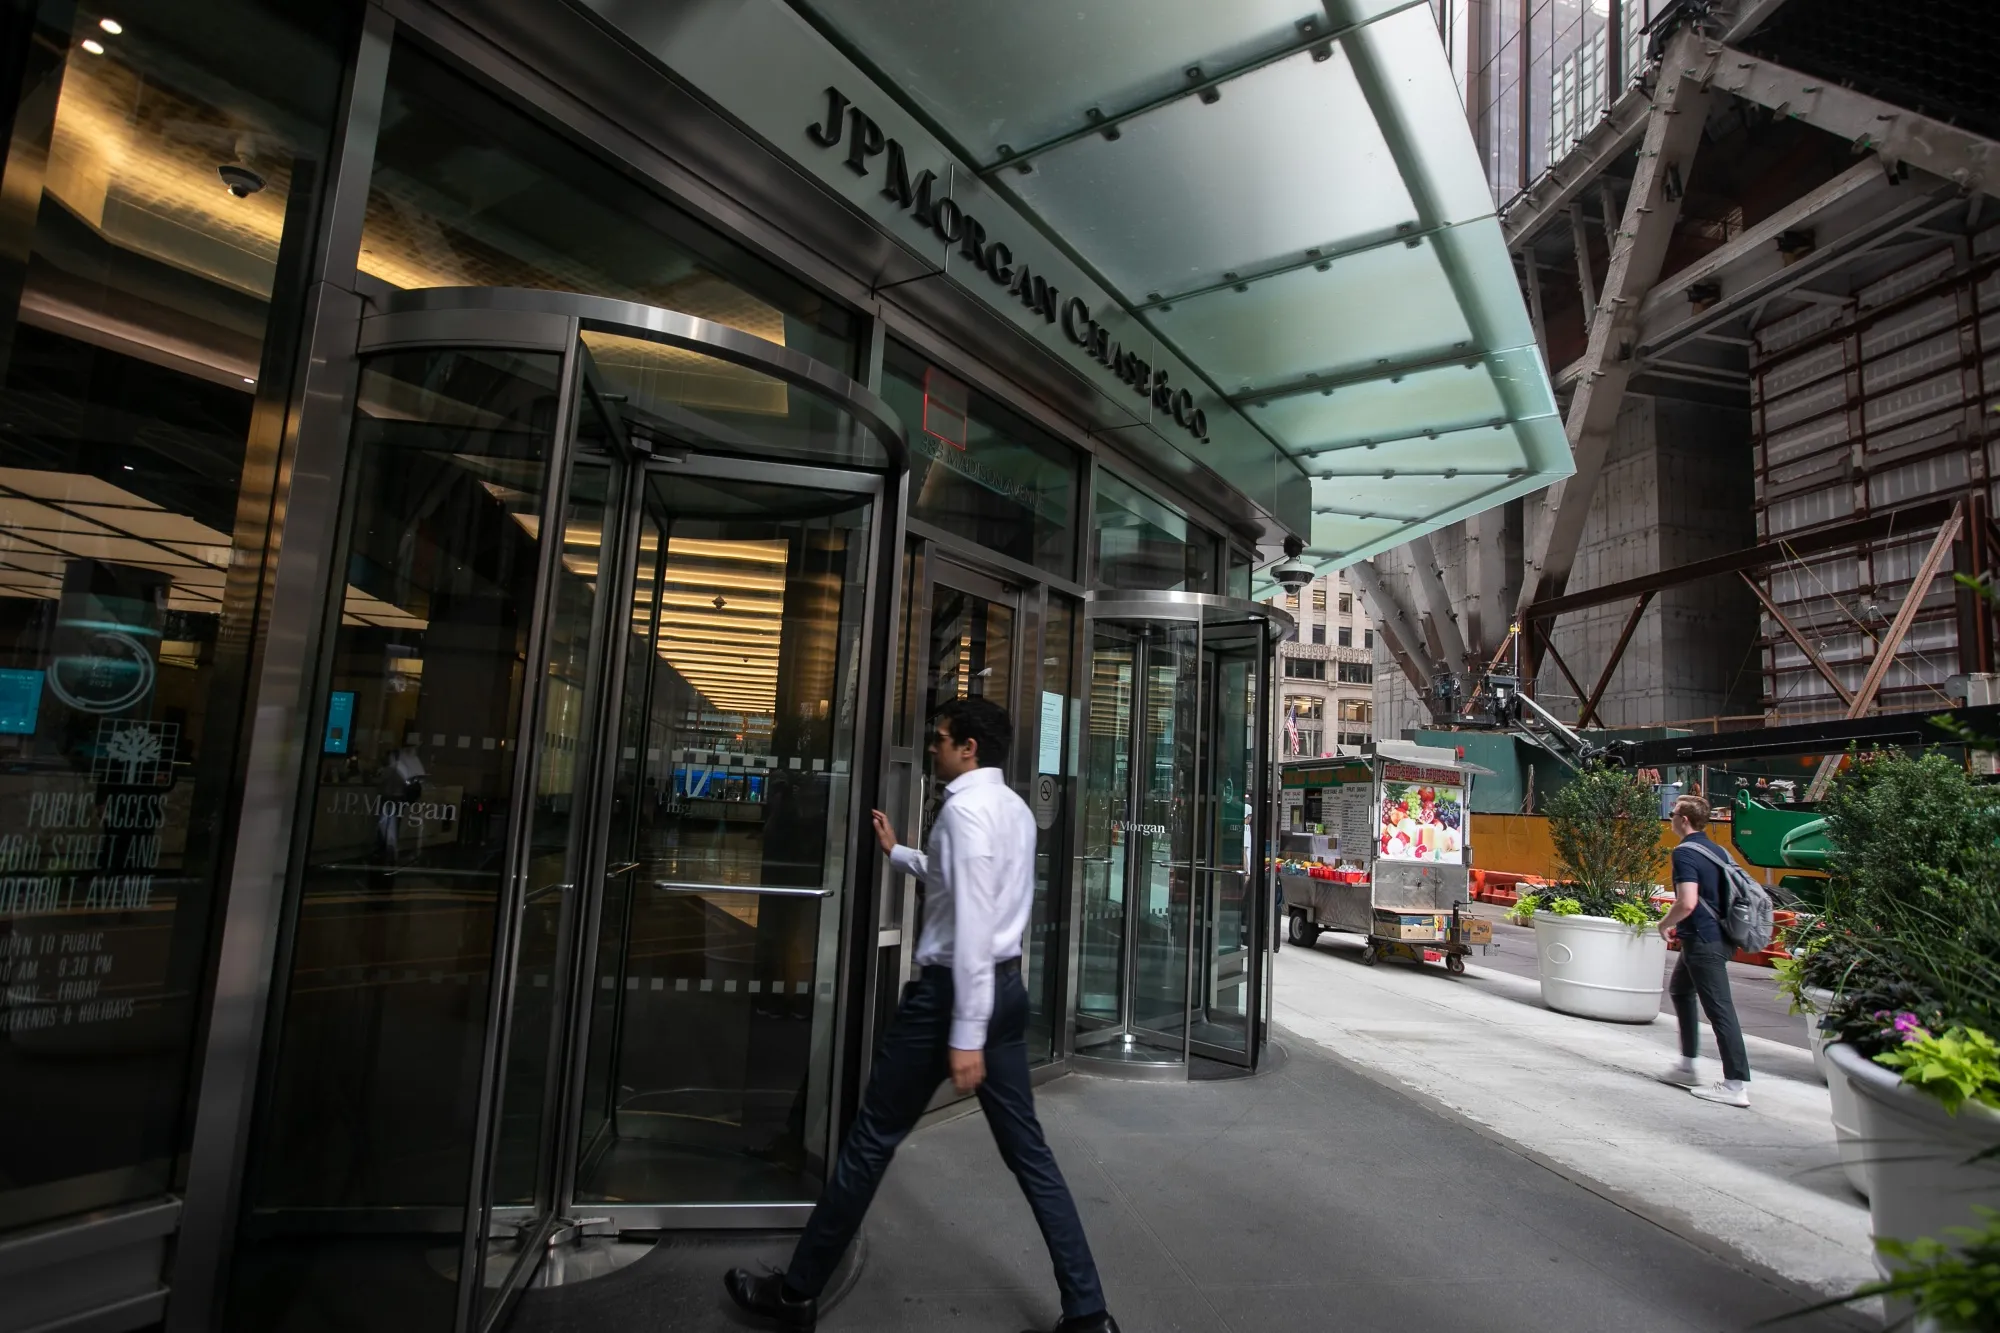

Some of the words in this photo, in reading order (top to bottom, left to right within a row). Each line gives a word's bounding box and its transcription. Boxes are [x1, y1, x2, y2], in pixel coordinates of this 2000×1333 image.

[27, 792, 96, 829] PUBLIC
[99, 793, 168, 829] ACCESS
[1100, 819, 1166, 836] J.PMorgan
[48, 833, 119, 871] STREET
[123, 833, 162, 869] AND
[0, 875, 79, 915] DERBILT
[85, 874, 156, 911] AVENUE
[40, 934, 57, 955] TO
[60, 932, 105, 953] PUBLIC
[18, 960, 39, 981] AM
[94, 954, 114, 974] PM
[58, 979, 102, 1002] FRIDAY
[0, 1006, 58, 1032] EEKENDS
[78, 998, 136, 1024] HOLIDAYS
